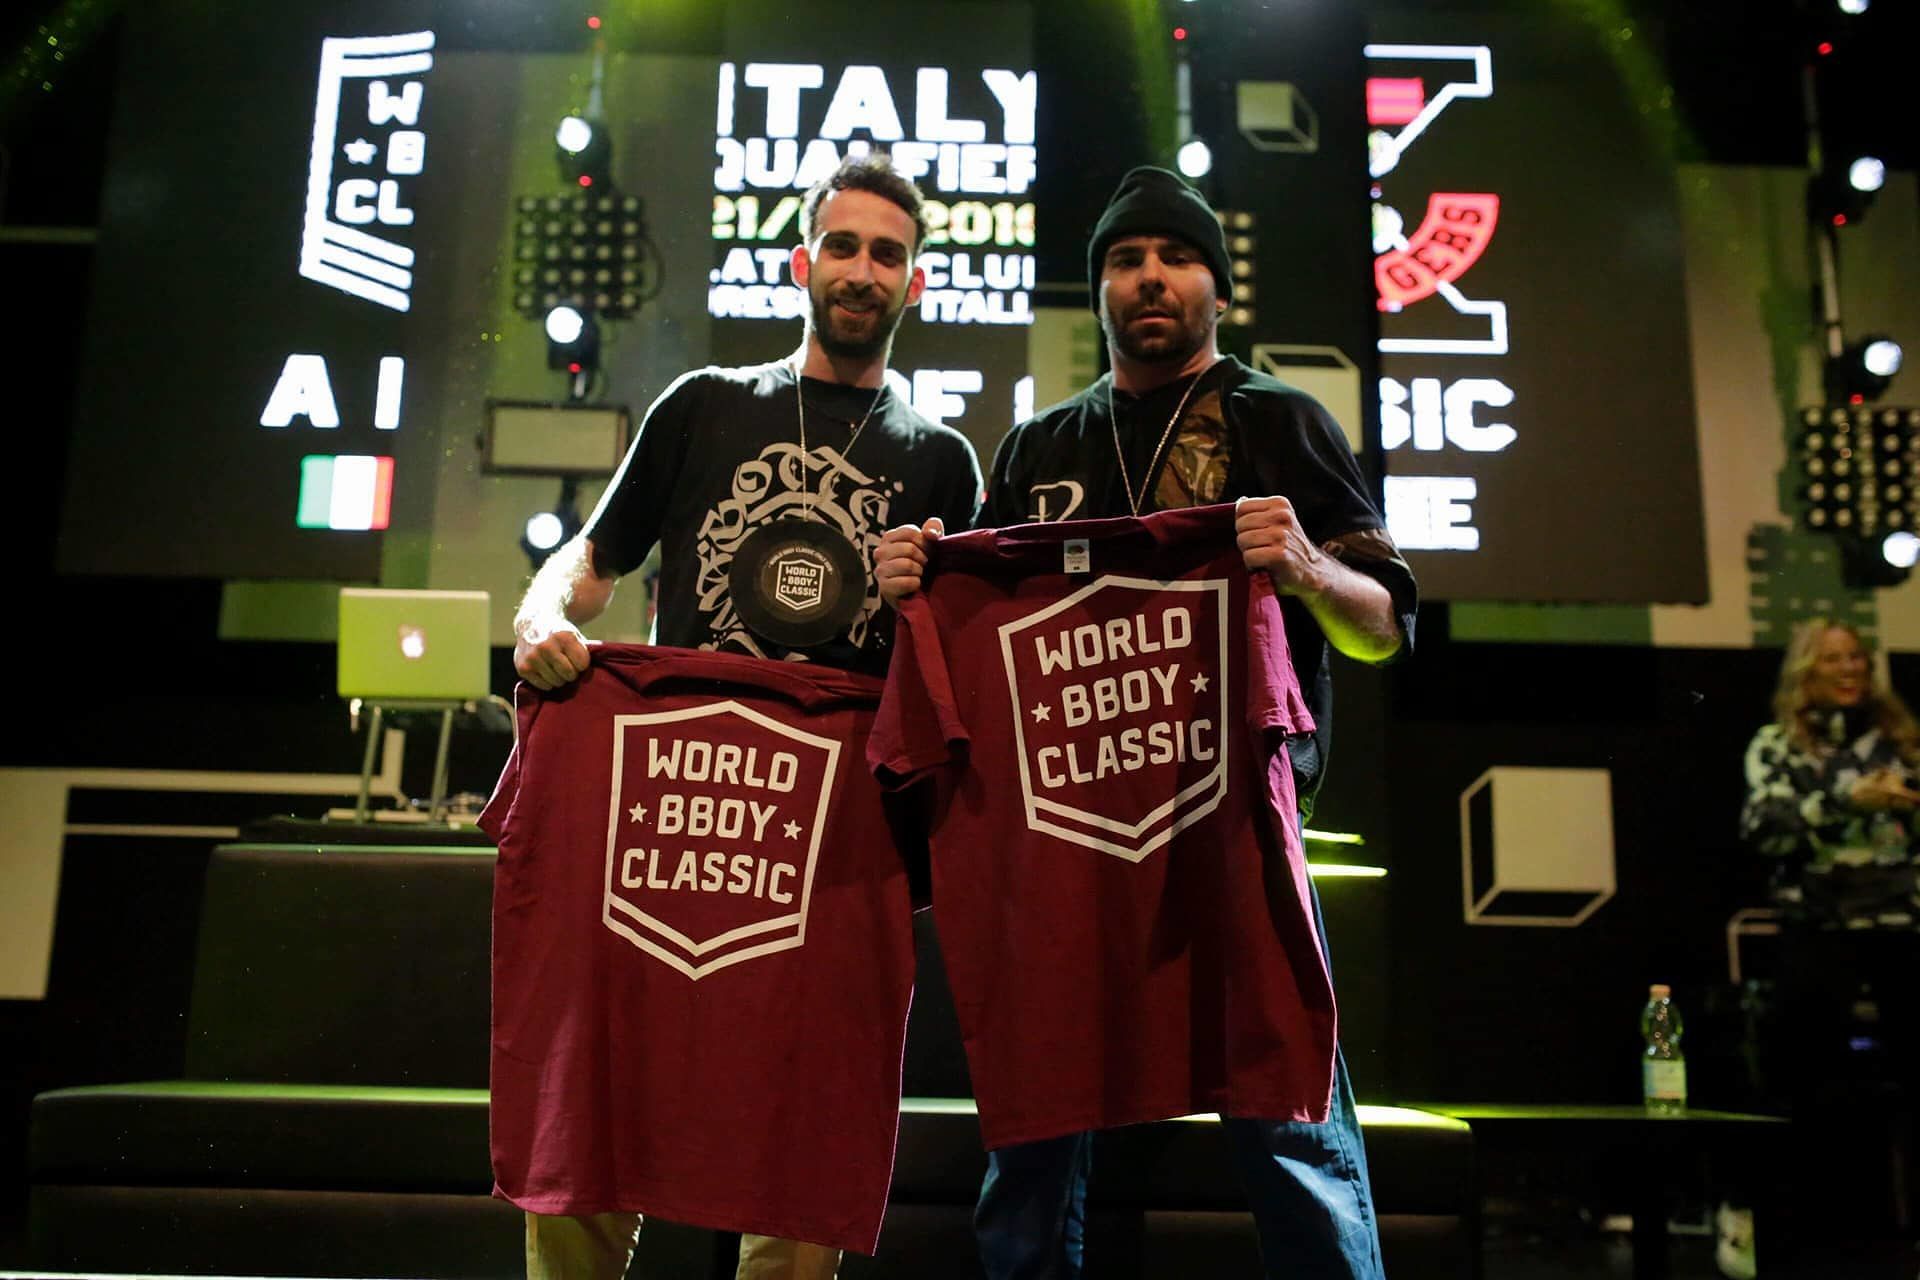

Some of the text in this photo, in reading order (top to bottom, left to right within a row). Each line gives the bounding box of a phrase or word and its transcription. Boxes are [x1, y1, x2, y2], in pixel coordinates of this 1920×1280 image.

[715, 62, 1038, 145] ITALY
[780, 585, 818, 597] CLASSIC
[785, 566, 817, 577] WORLD
[787, 576, 813, 586] BBOY
[1034, 606, 1193, 676] WORLD
[1061, 663, 1181, 728] BBOY
[647, 737, 799, 793] WORLD
[1036, 718, 1215, 789] CLASSIC
[656, 793, 779, 842] BBOY
[620, 847, 797, 905] CLASSIC
